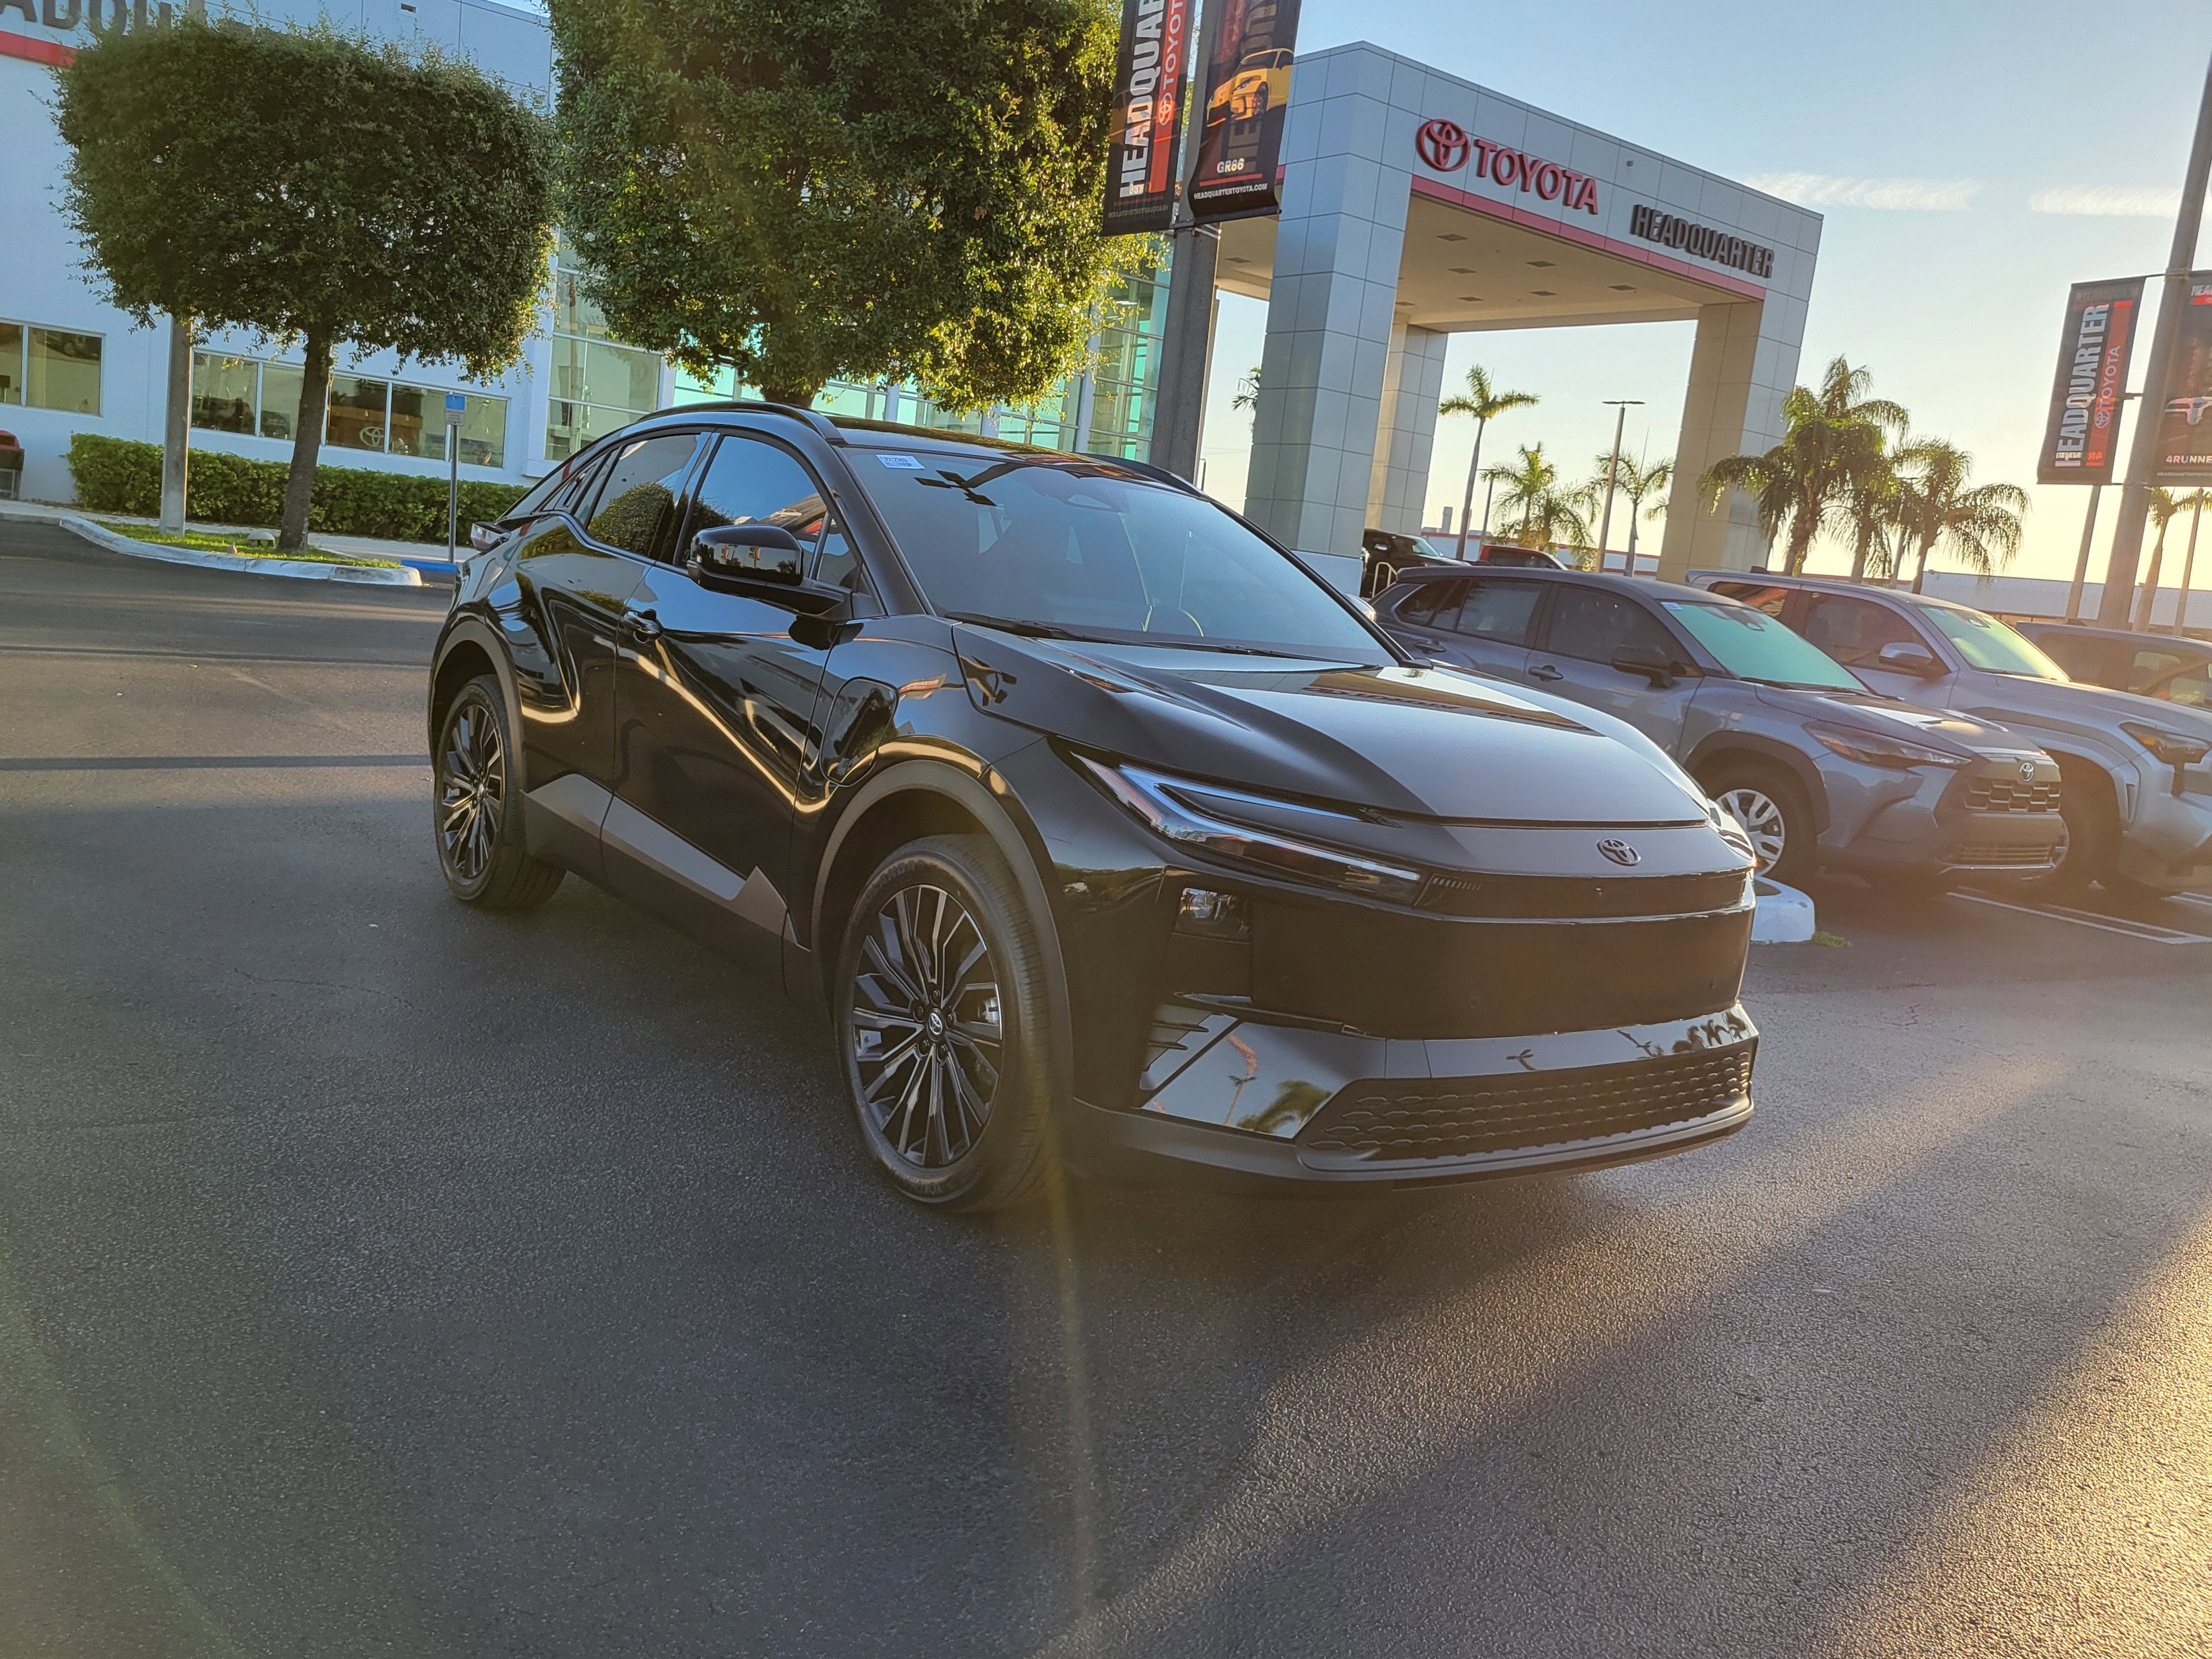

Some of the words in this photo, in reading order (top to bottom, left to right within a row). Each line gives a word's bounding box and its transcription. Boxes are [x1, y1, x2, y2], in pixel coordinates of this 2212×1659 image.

[1194, 183, 1268, 200] HEADQUARTERTOYOTA.COM
[1216, 158, 1245, 174] GR86
[1473, 138, 1599, 215] TOYOTA
[1630, 204, 1775, 279] HEADQUARTER
[2055, 303, 2110, 467] HEADQUARTER
[2098, 345, 2121, 408] TOYOTA
